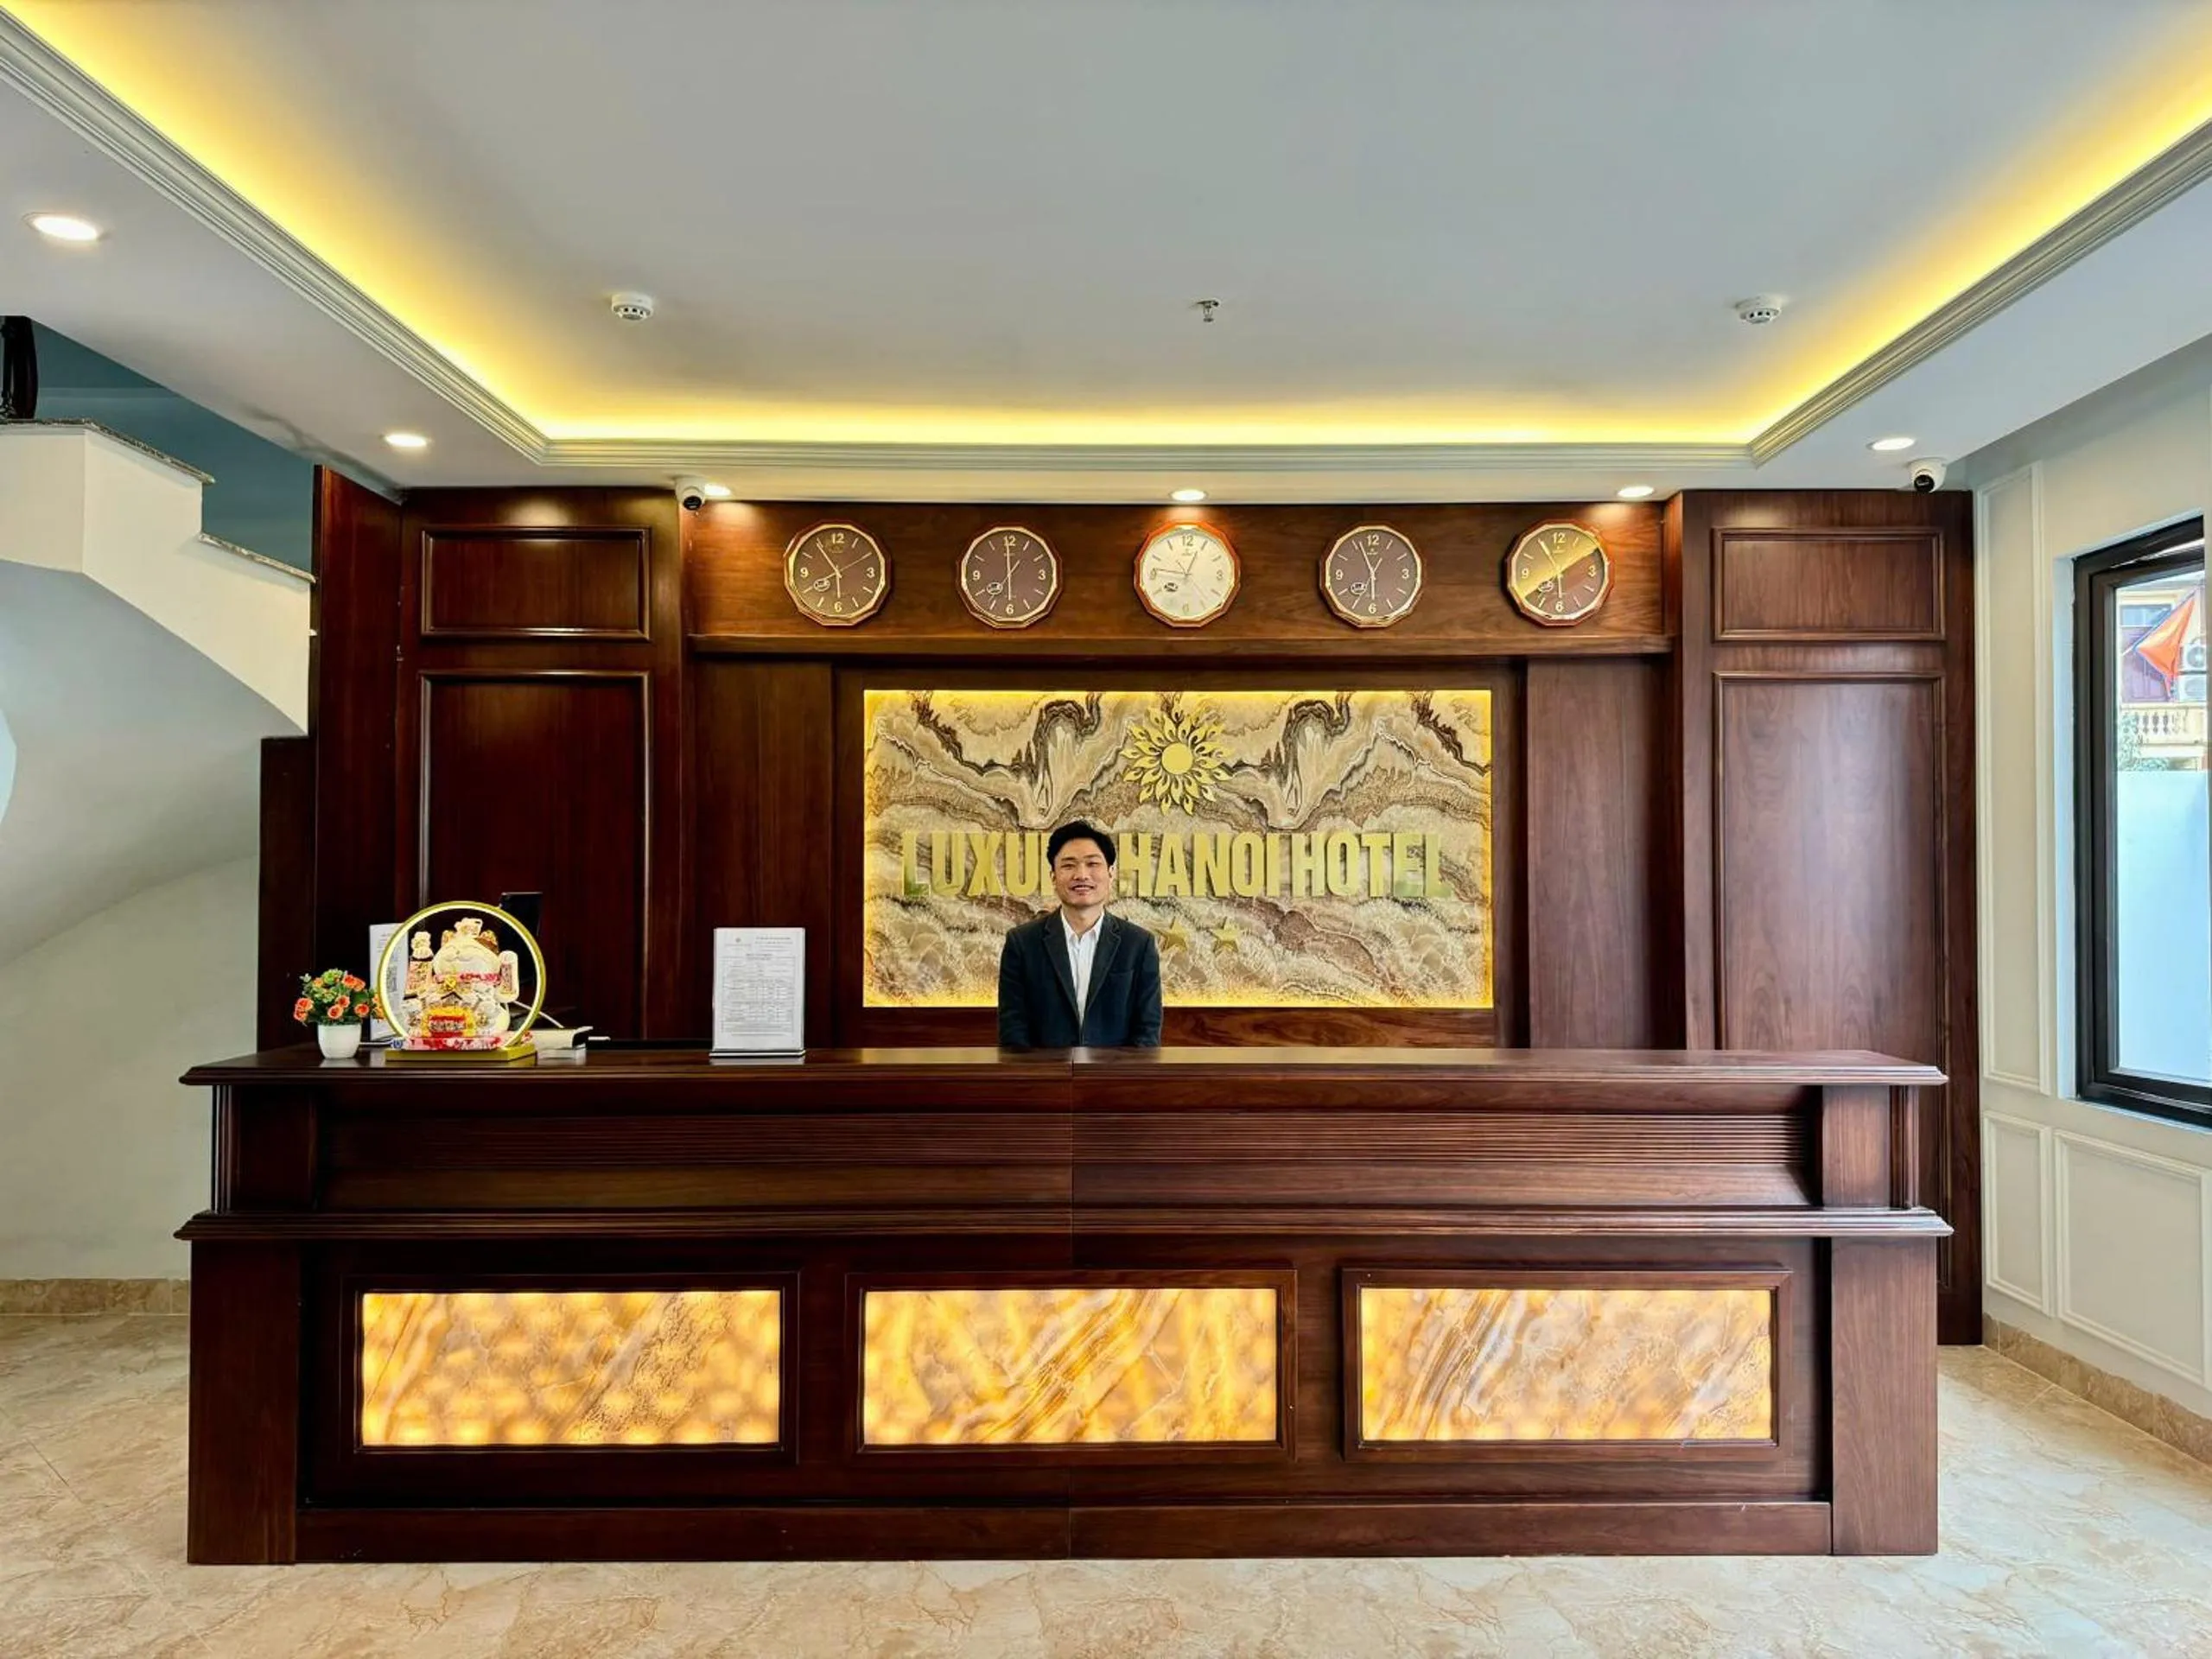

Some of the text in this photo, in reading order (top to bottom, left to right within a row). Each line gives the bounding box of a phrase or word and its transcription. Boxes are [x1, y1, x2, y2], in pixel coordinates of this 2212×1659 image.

[831, 533, 845, 544] 12
[1004, 535, 1016, 547] 12
[1181, 536, 1193, 547] 12
[1366, 534, 1380, 546] 12
[1554, 532, 1566, 543] 12
[800, 567, 809, 578] 9
[867, 567, 875, 578] 3
[972, 570, 981, 581] 9
[1038, 569, 1046, 581] 3
[1216, 570, 1224, 581] 3
[1335, 569, 1344, 581] 9
[1402, 568, 1409, 579] 3
[1522, 568, 1529, 579] 9
[1588, 565, 1597, 577] 3
[834, 601, 842, 613] 6
[1006, 604, 1014, 614] 6
[1368, 602, 1376, 614] 6
[1555, 601, 1564, 613] 6
[903, 830, 1452, 897] LUXU HANOI HOTEL
